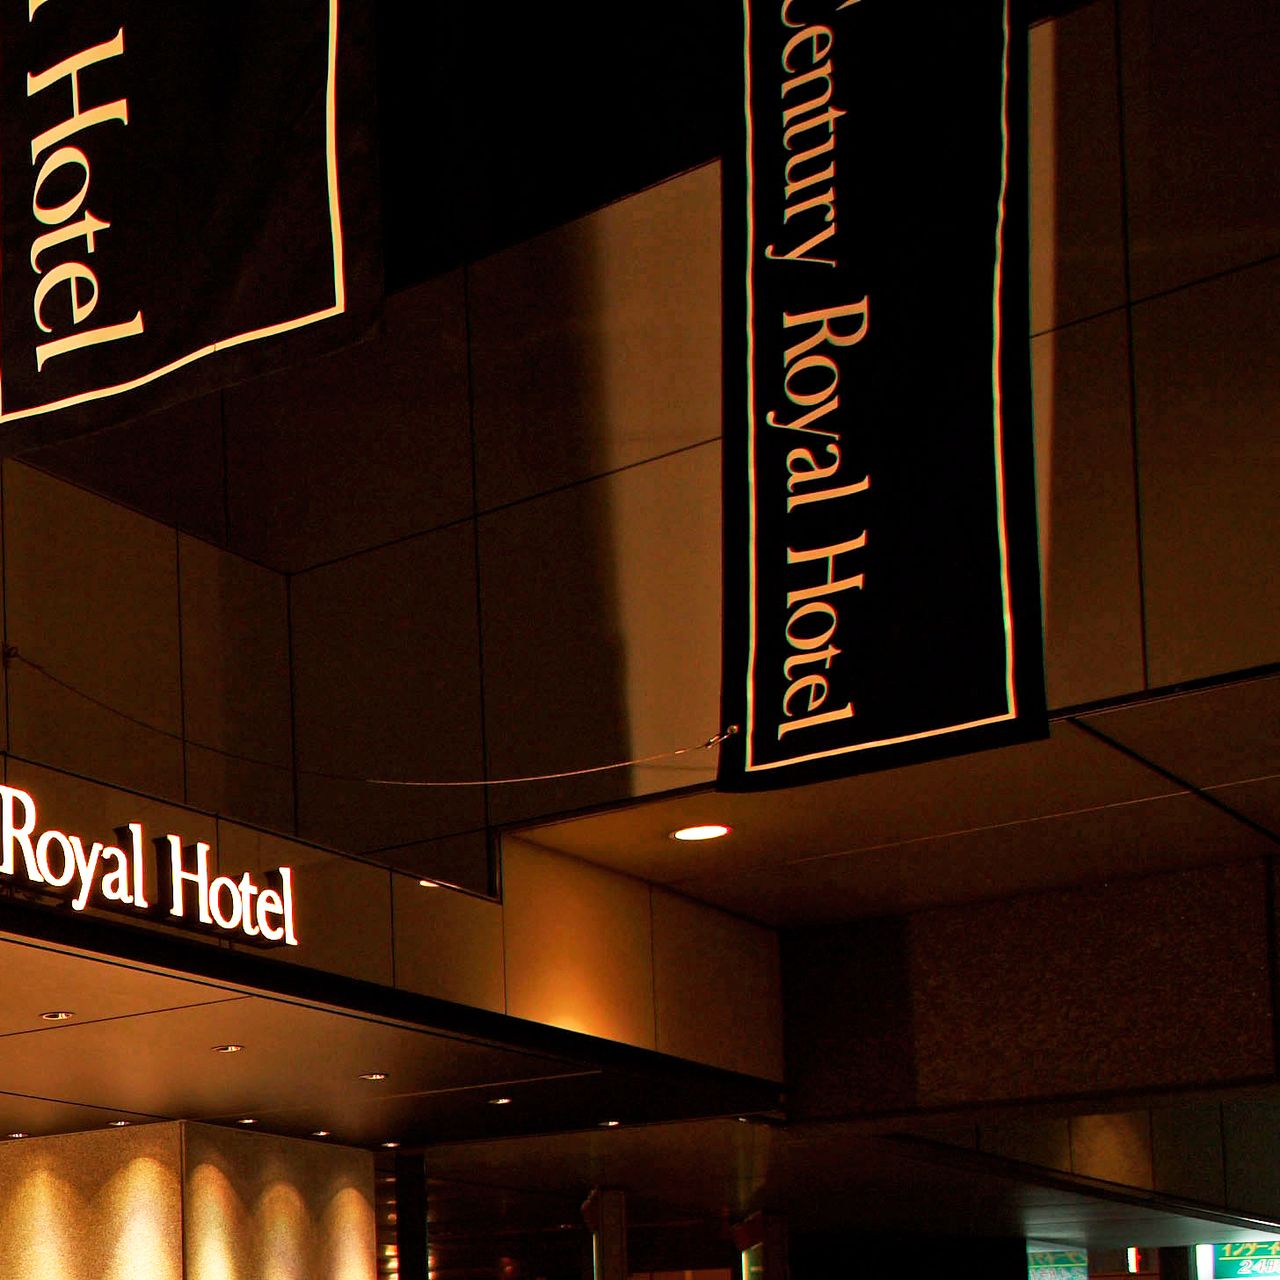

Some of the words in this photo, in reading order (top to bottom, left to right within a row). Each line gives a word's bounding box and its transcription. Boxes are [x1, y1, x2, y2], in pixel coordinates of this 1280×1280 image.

[26, 26, 145, 373] Hotel
[765, 295, 871, 513] Royal
[777, 529, 868, 741] Hotel
[166, 834, 300, 946] Hotel
